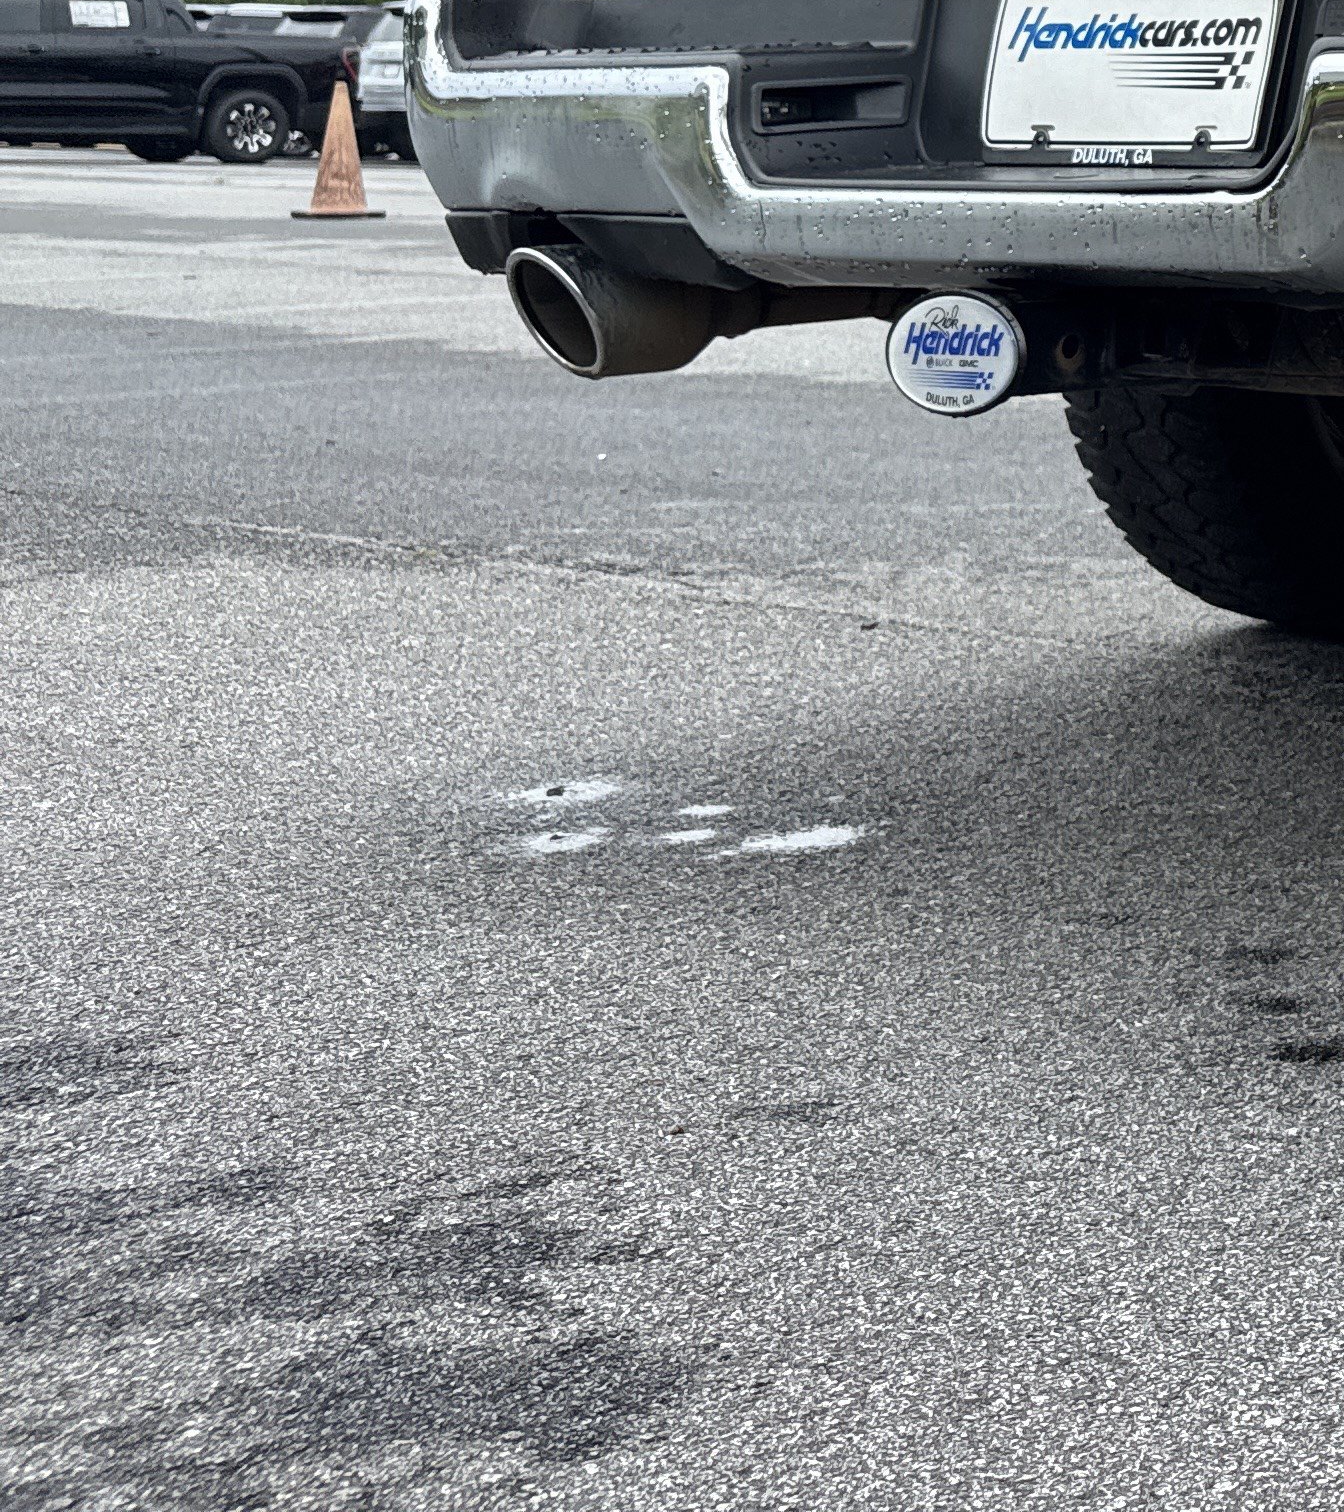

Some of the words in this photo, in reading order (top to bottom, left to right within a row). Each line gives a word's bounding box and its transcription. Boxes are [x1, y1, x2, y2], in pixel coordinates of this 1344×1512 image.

[1008, 6, 1263, 62] Hendrickcars.com
[1072, 148, 1130, 167] DULUTH,
[1133, 149, 1154, 165] GA
[925, 305, 959, 337] Rick
[903, 322, 1005, 365] Hendrick
[925, 392, 961, 408] DULUTH,
[962, 392, 975, 406] GA
